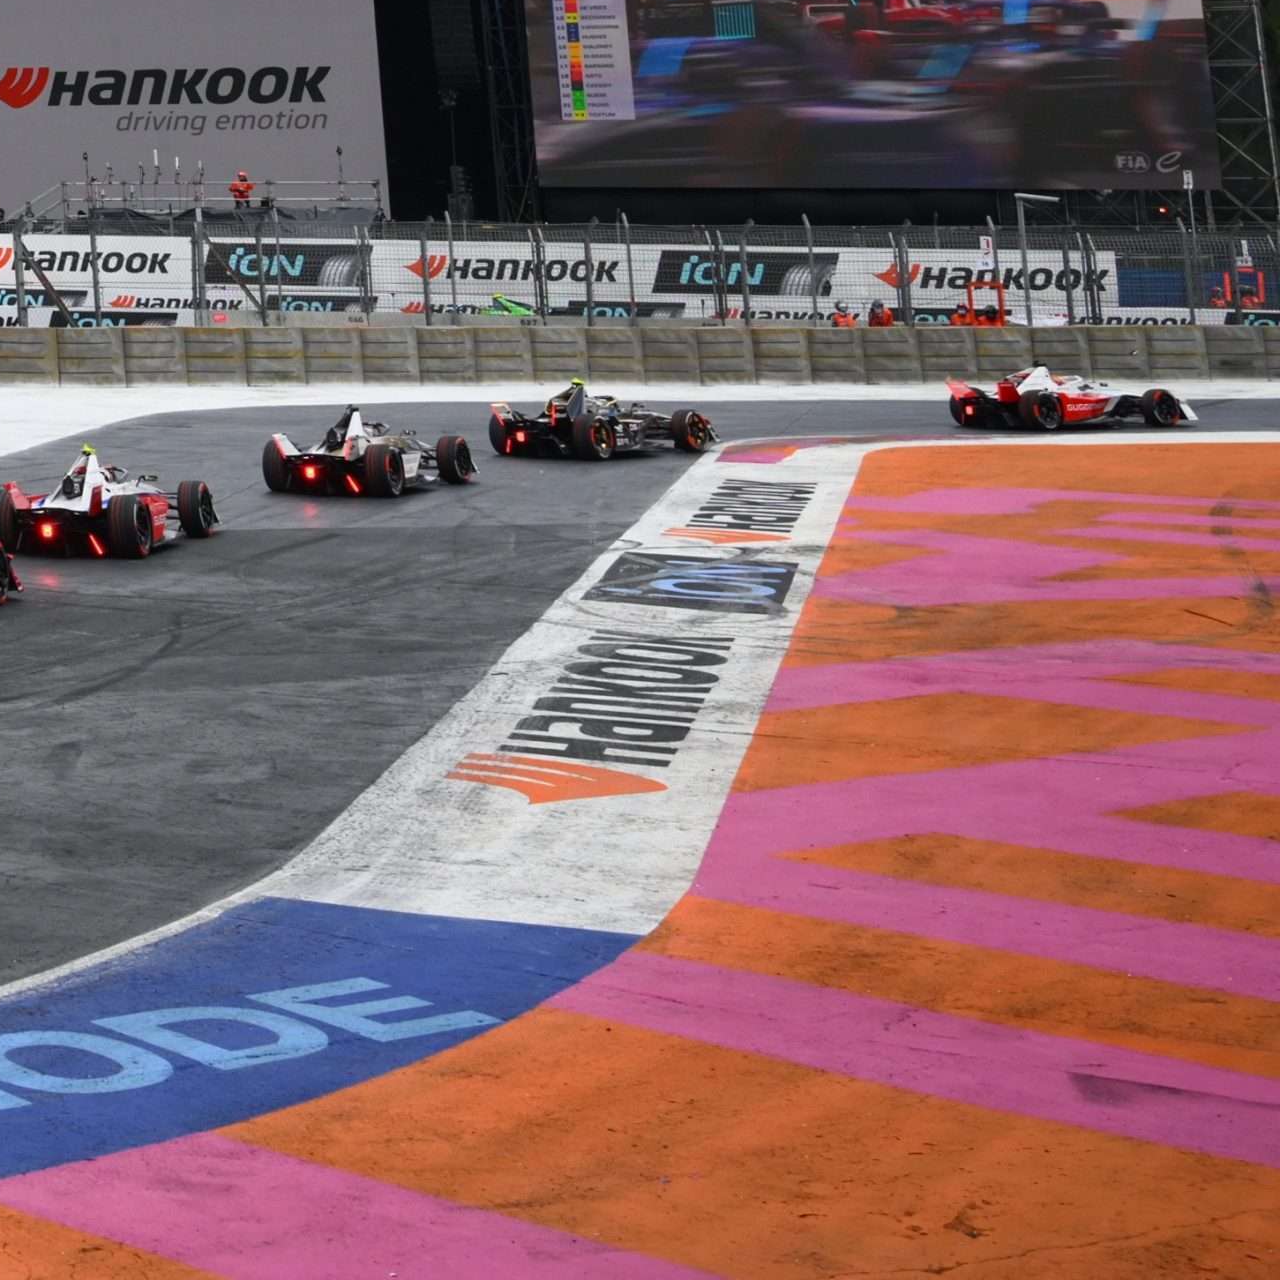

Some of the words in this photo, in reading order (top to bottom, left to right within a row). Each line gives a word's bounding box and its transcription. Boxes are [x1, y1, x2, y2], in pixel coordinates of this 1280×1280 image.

[47, 65, 332, 107] HanKOOK
[115, 110, 208, 136] driving
[215, 109, 328, 132] emotion
